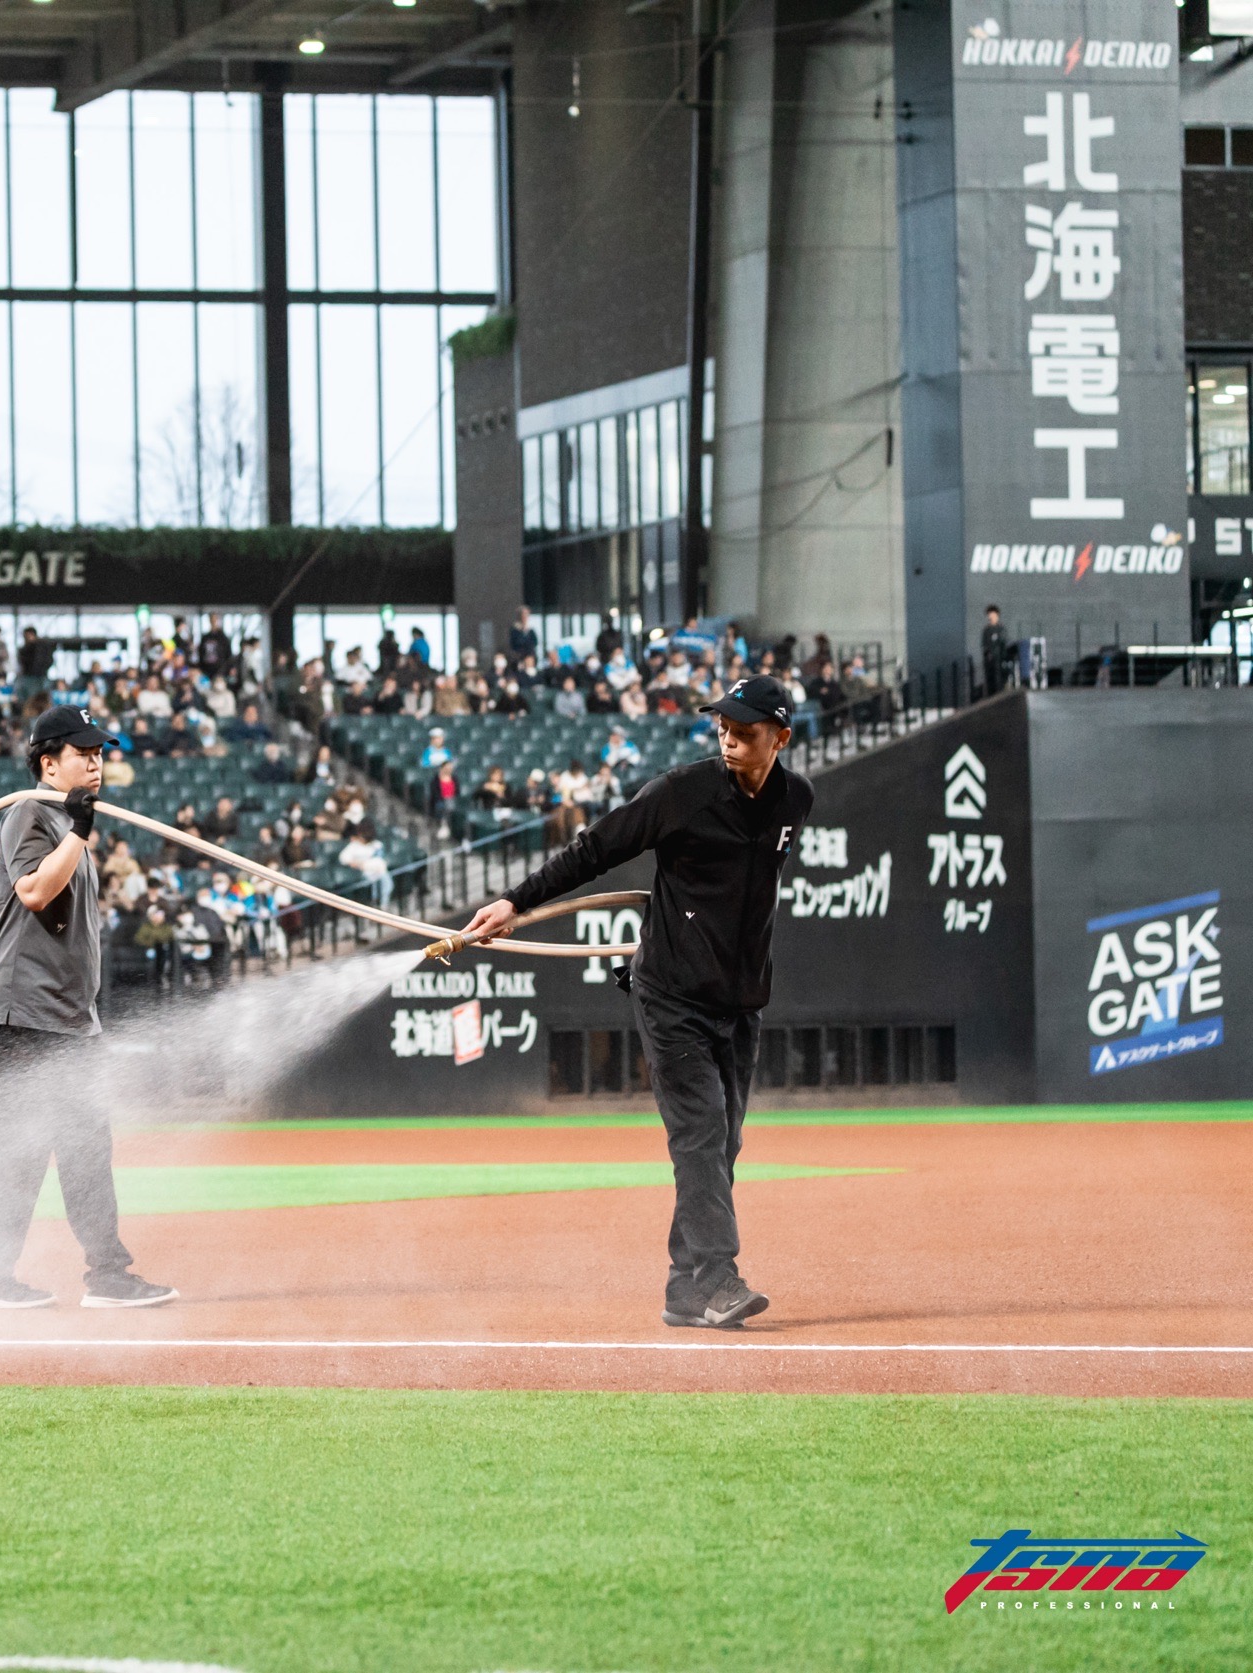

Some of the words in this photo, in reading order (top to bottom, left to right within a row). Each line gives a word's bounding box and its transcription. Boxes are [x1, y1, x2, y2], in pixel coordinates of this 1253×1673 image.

[962, 37, 1065, 66] HOKKAI
[1023, 91, 1125, 519] 北海電工
[1214, 517, 1253, 556] S
[970, 543, 1076, 573] HOKKAI
[777, 826, 793, 851] F
[927, 831, 1007, 888] アトラス
[944, 898, 993, 933] グループ
[1087, 907, 1221, 992] ASK
[495, 972, 536, 998] PARK
[1087, 963, 1224, 1037] GATE
